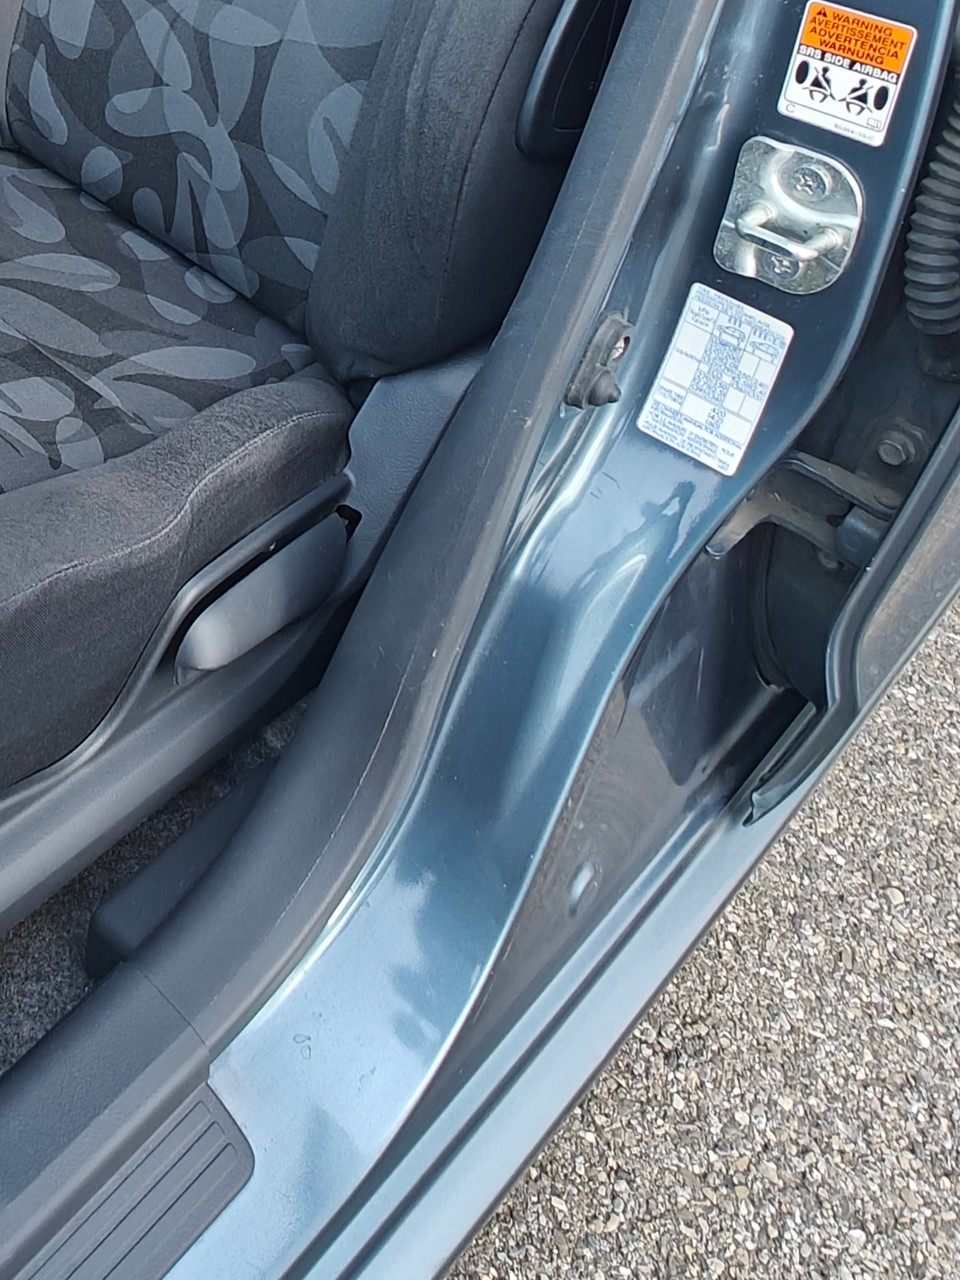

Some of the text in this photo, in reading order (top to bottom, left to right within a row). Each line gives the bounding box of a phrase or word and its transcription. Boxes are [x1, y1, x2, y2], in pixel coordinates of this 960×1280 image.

[809, 15, 906, 50] AVERTISSEMENT
[832, 11, 893, 37] WARNING
[809, 26, 900, 59] ADVERTENCIA
[819, 38, 885, 65] WARNUNG
[799, 45, 898, 83] SRS SIDE AIRBAG
